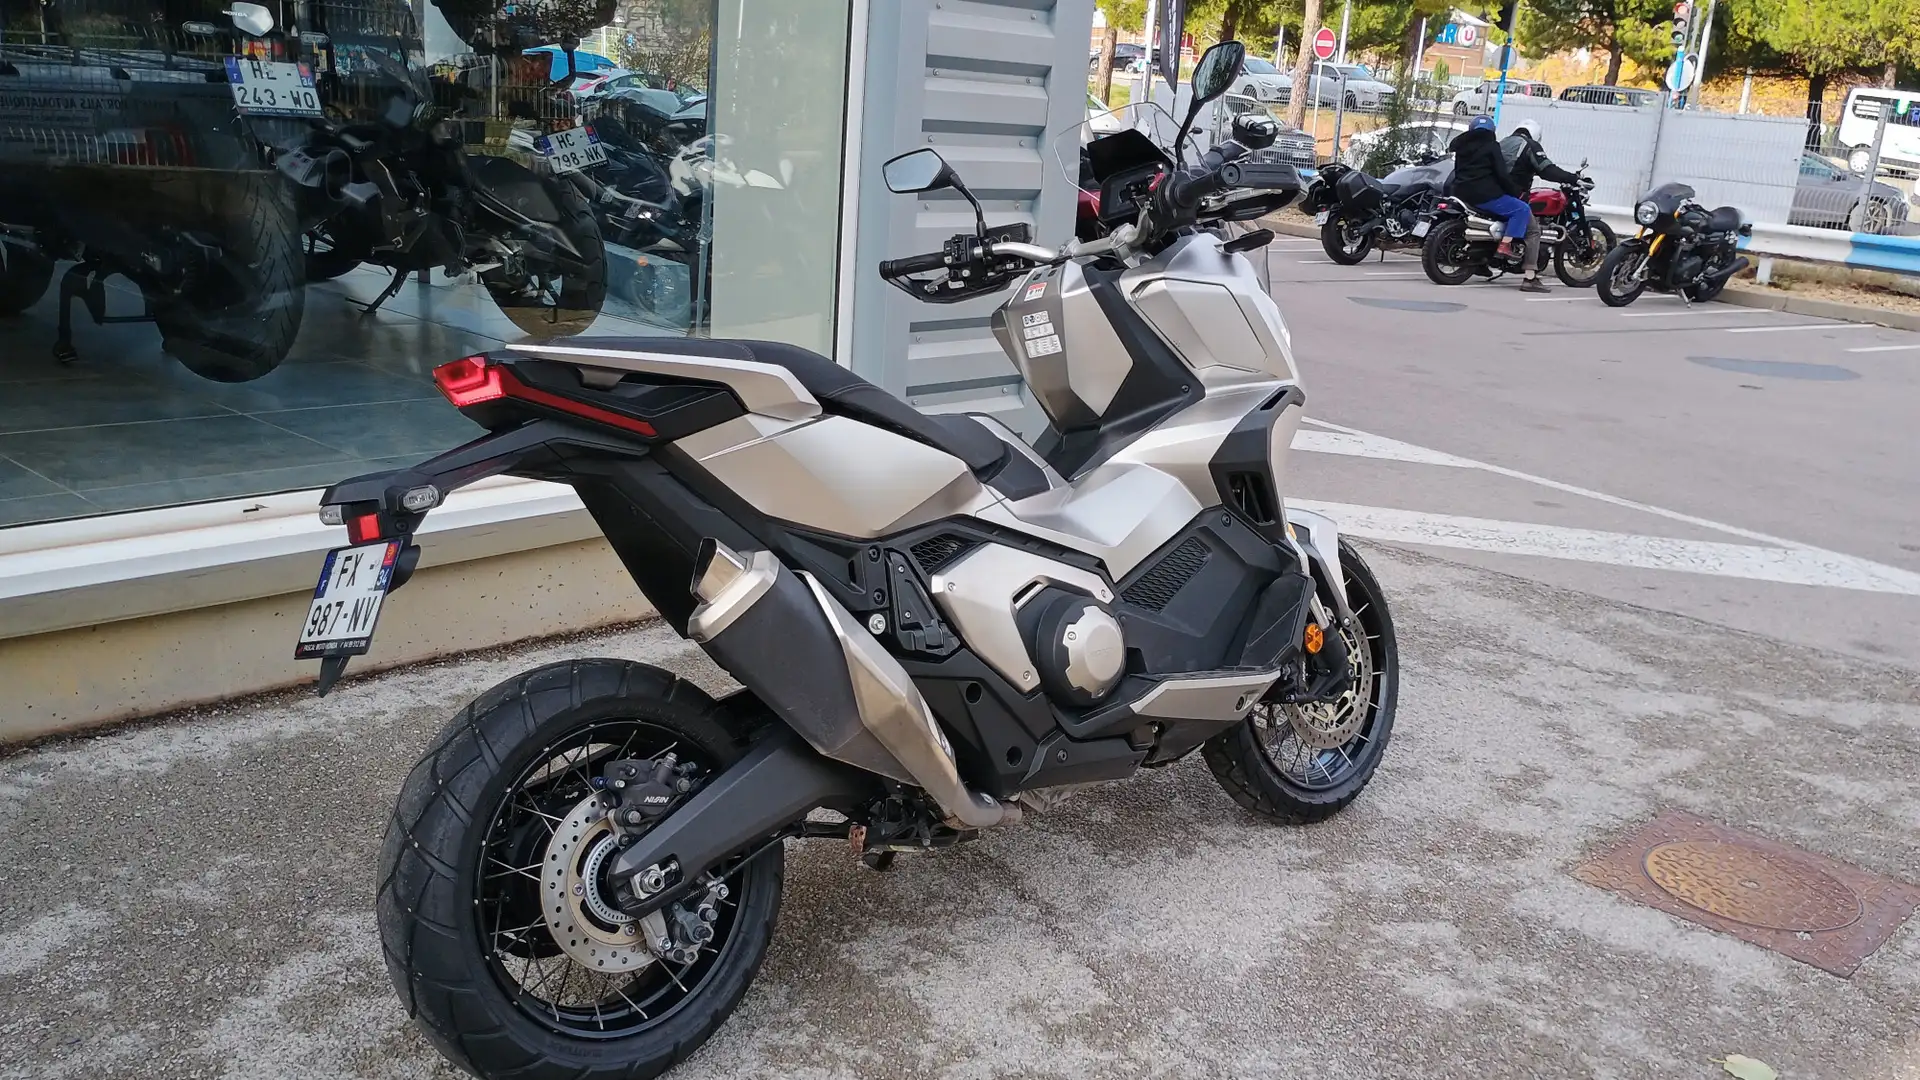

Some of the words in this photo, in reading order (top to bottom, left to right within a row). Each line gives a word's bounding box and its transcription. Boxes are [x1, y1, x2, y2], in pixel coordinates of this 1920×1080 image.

[301, 77, 313, 87] 34
[237, 86, 316, 109] 243-WQ
[556, 133, 575, 149] HC
[552, 146, 603, 170] 798-NK
[336, 553, 364, 589] FX
[375, 568, 390, 587] 34
[307, 596, 378, 637] 987-NV
